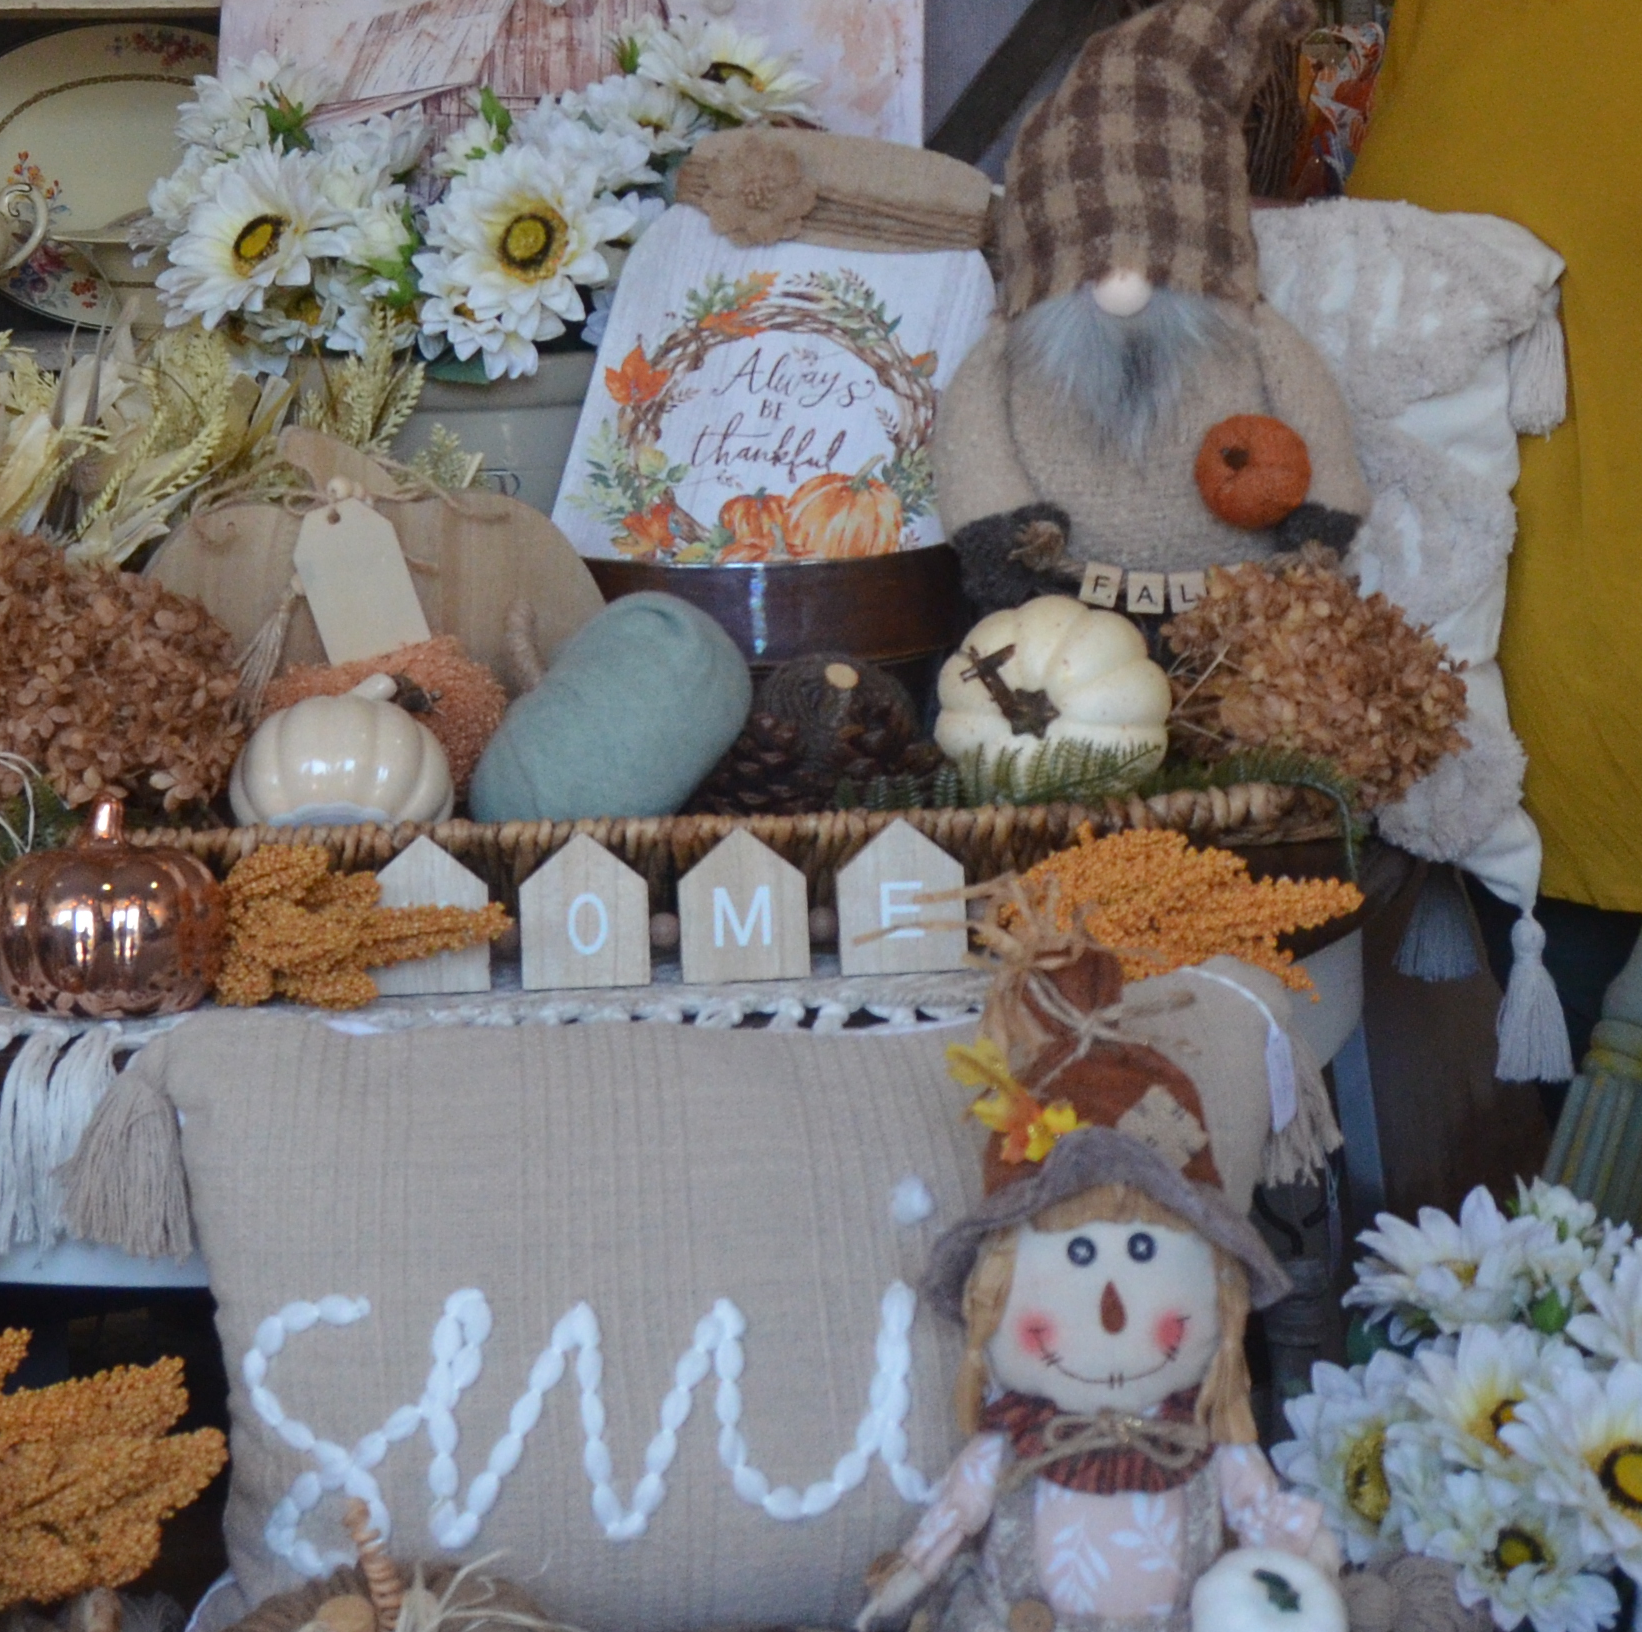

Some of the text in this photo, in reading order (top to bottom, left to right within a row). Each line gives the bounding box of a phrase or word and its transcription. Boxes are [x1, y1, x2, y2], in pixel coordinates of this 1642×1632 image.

[712, 347, 876, 408] Always
[760, 398, 785, 421] BE
[689, 413, 847, 483] thankful
[1091, 574, 1195, 605] FAL
[566, 880, 926, 956] OME
